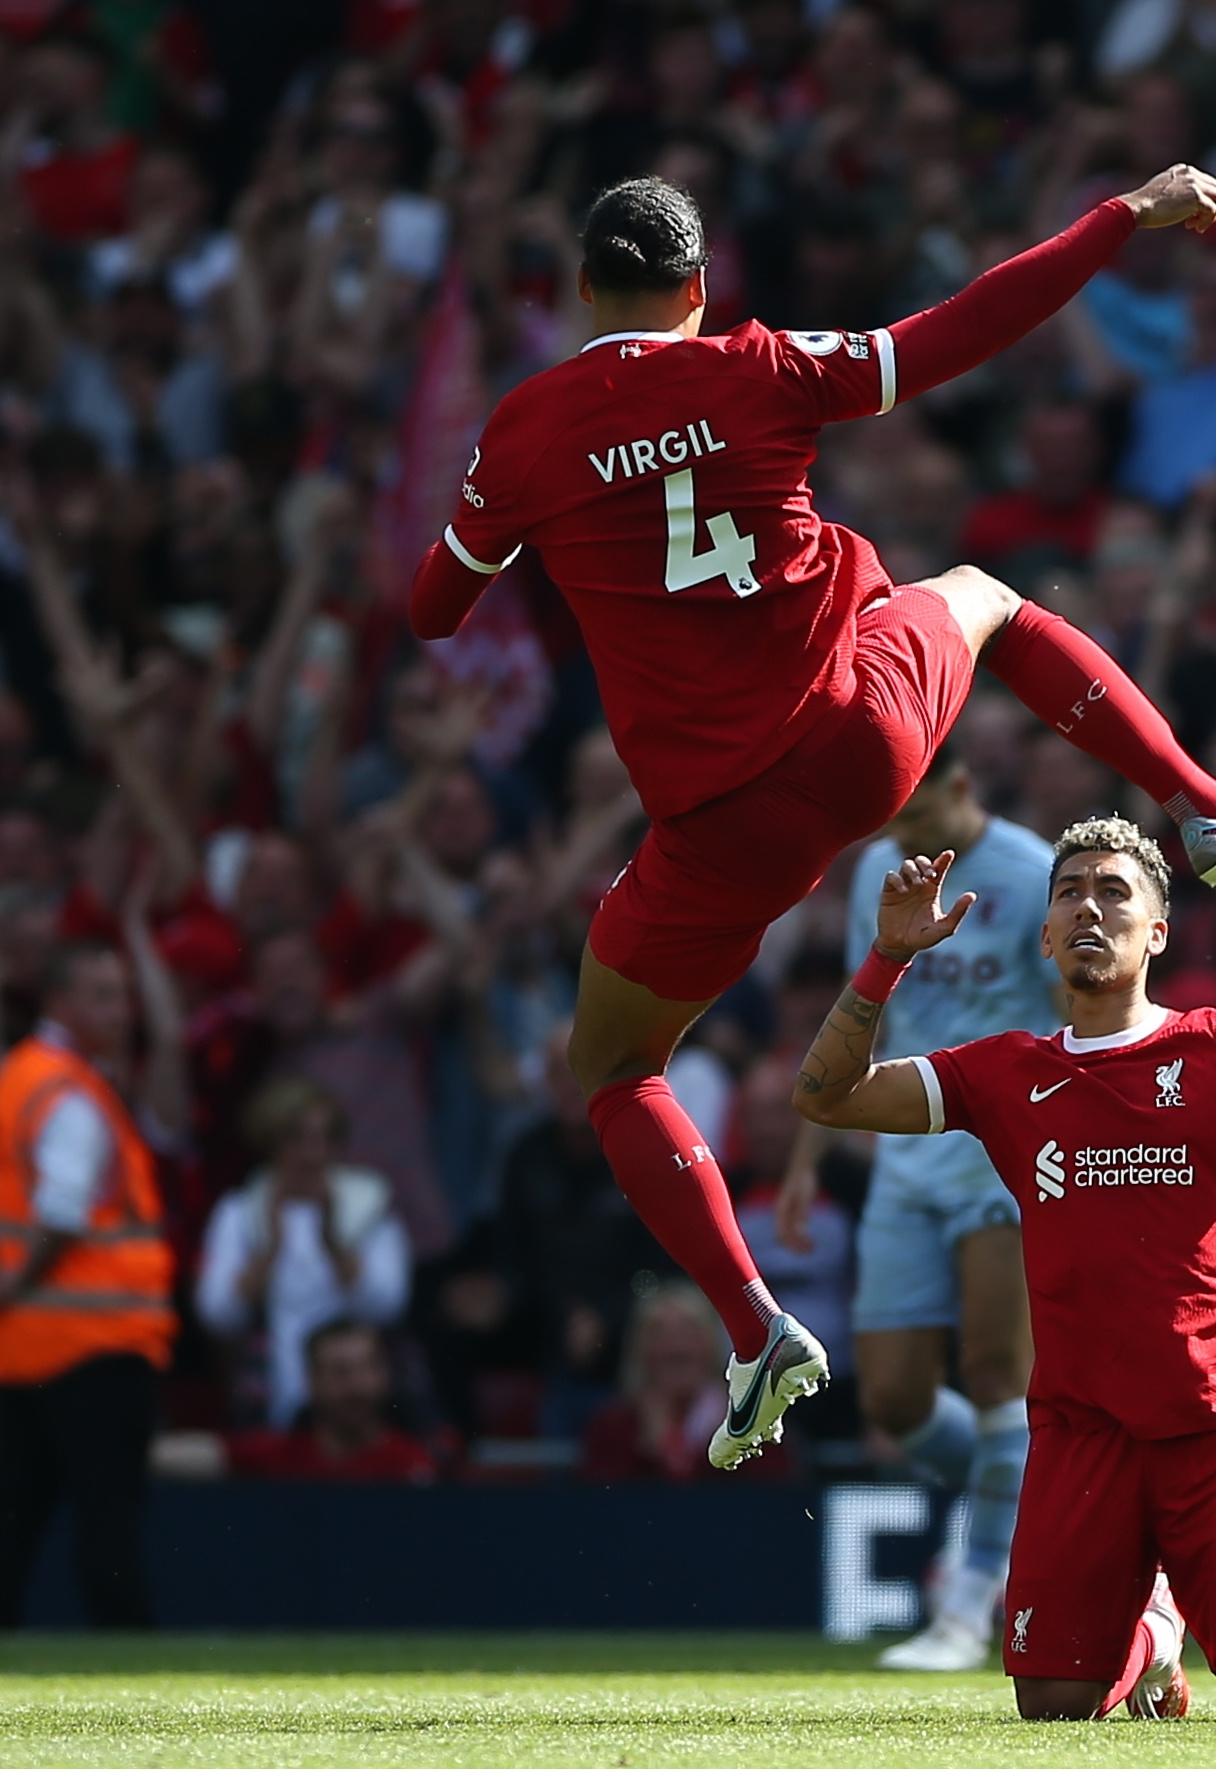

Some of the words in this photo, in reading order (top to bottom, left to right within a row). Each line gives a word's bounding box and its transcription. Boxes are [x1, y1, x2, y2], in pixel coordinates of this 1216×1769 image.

[588, 420, 727, 483] VIRGIL
[664, 467, 762, 599] 4
[1074, 1143, 1187, 1167] standard
[1074, 1164, 1194, 1187] chartered
